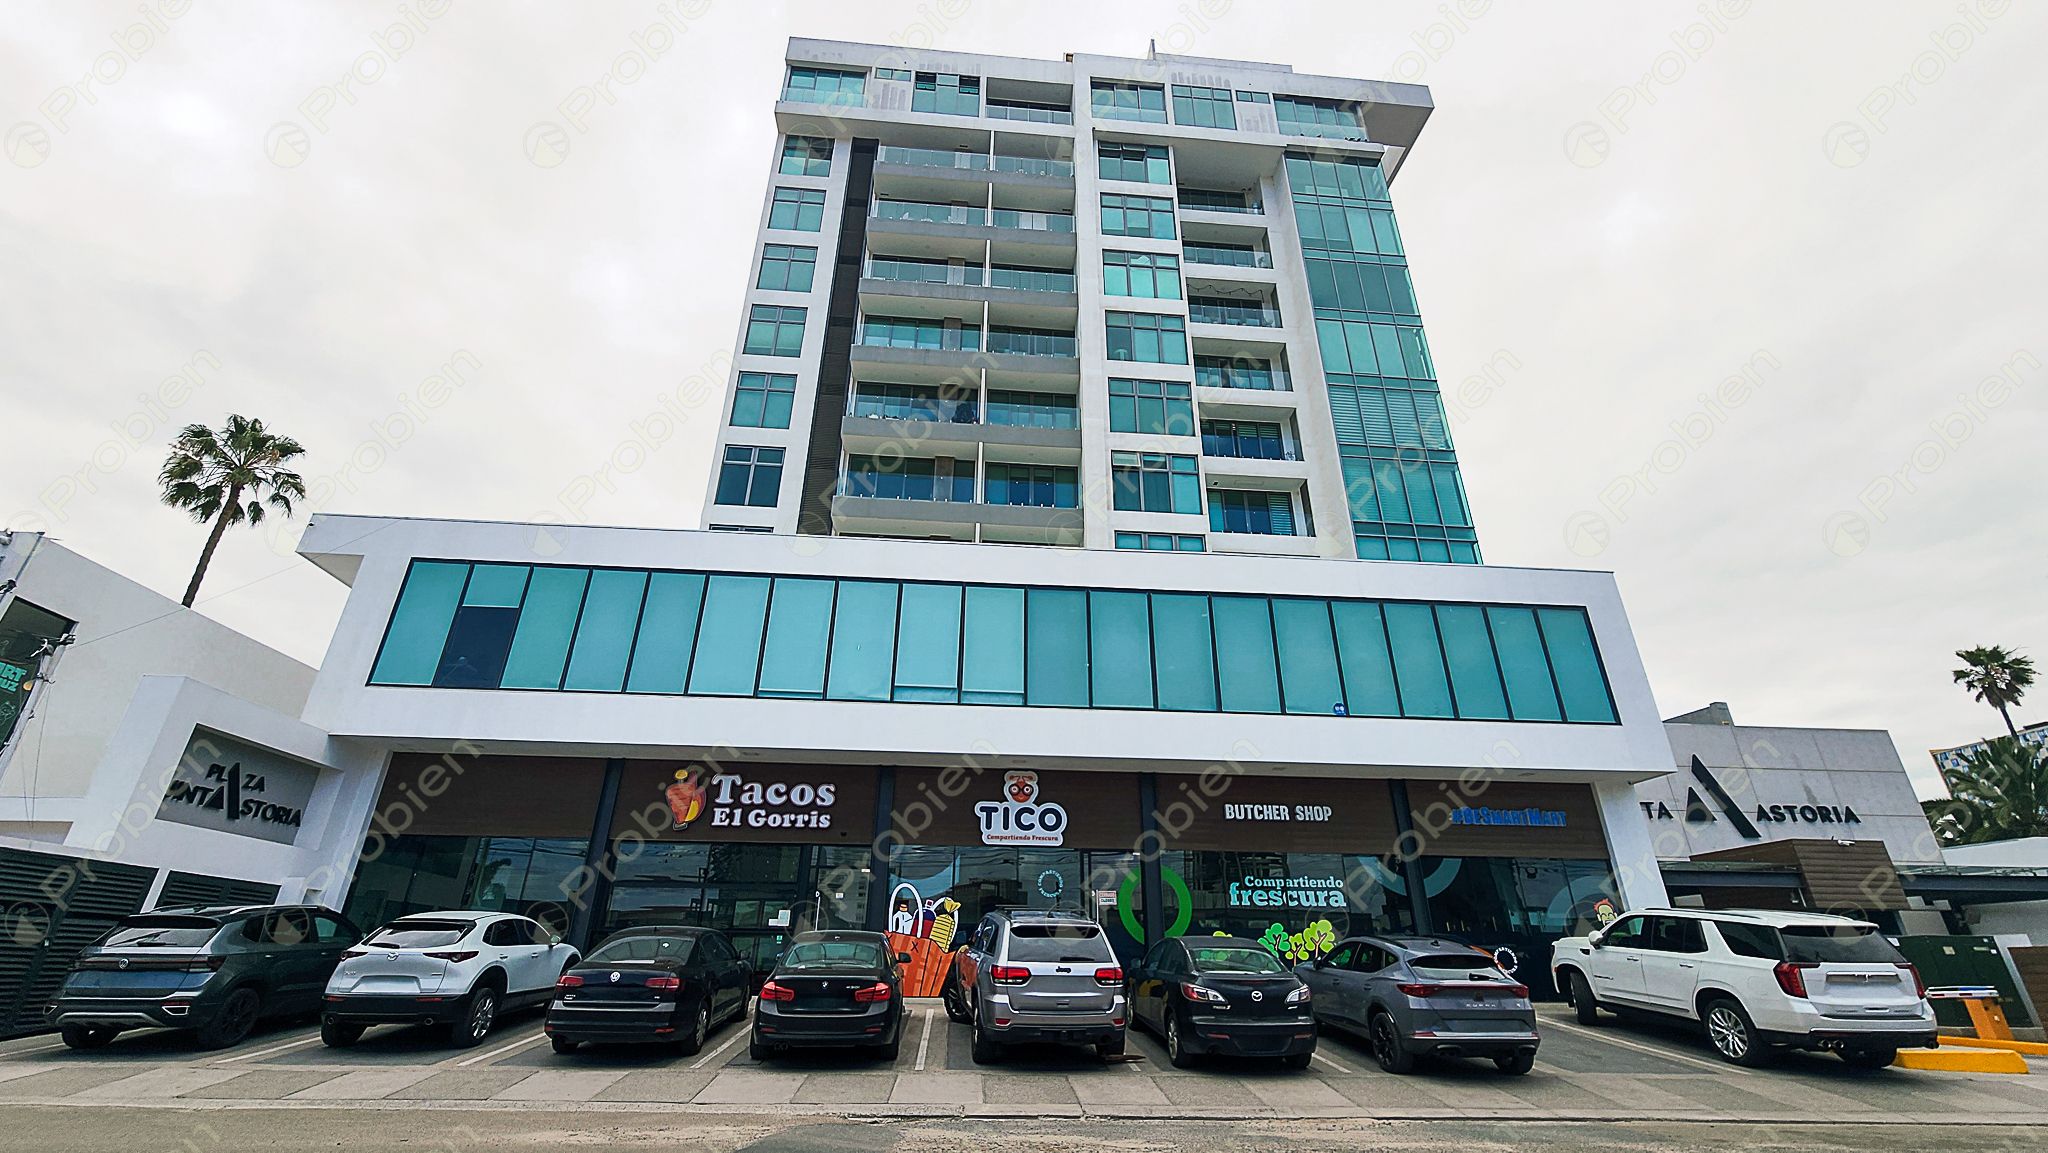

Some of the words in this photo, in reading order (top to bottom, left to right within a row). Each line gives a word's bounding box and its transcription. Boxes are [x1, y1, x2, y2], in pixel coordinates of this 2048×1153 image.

[712, 774, 836, 806] Tacos
[711, 808, 743, 826] El
[747, 810, 831, 828] Gorris
[979, 806, 1062, 832] TICO
[1225, 804, 1289, 820] BUTCHER
[1296, 805, 1332, 821] SHOP
[1756, 803, 1861, 824] ASTORIA
[1244, 875, 1344, 890] Compartiendo
[1229, 882, 1347, 907] frescura
